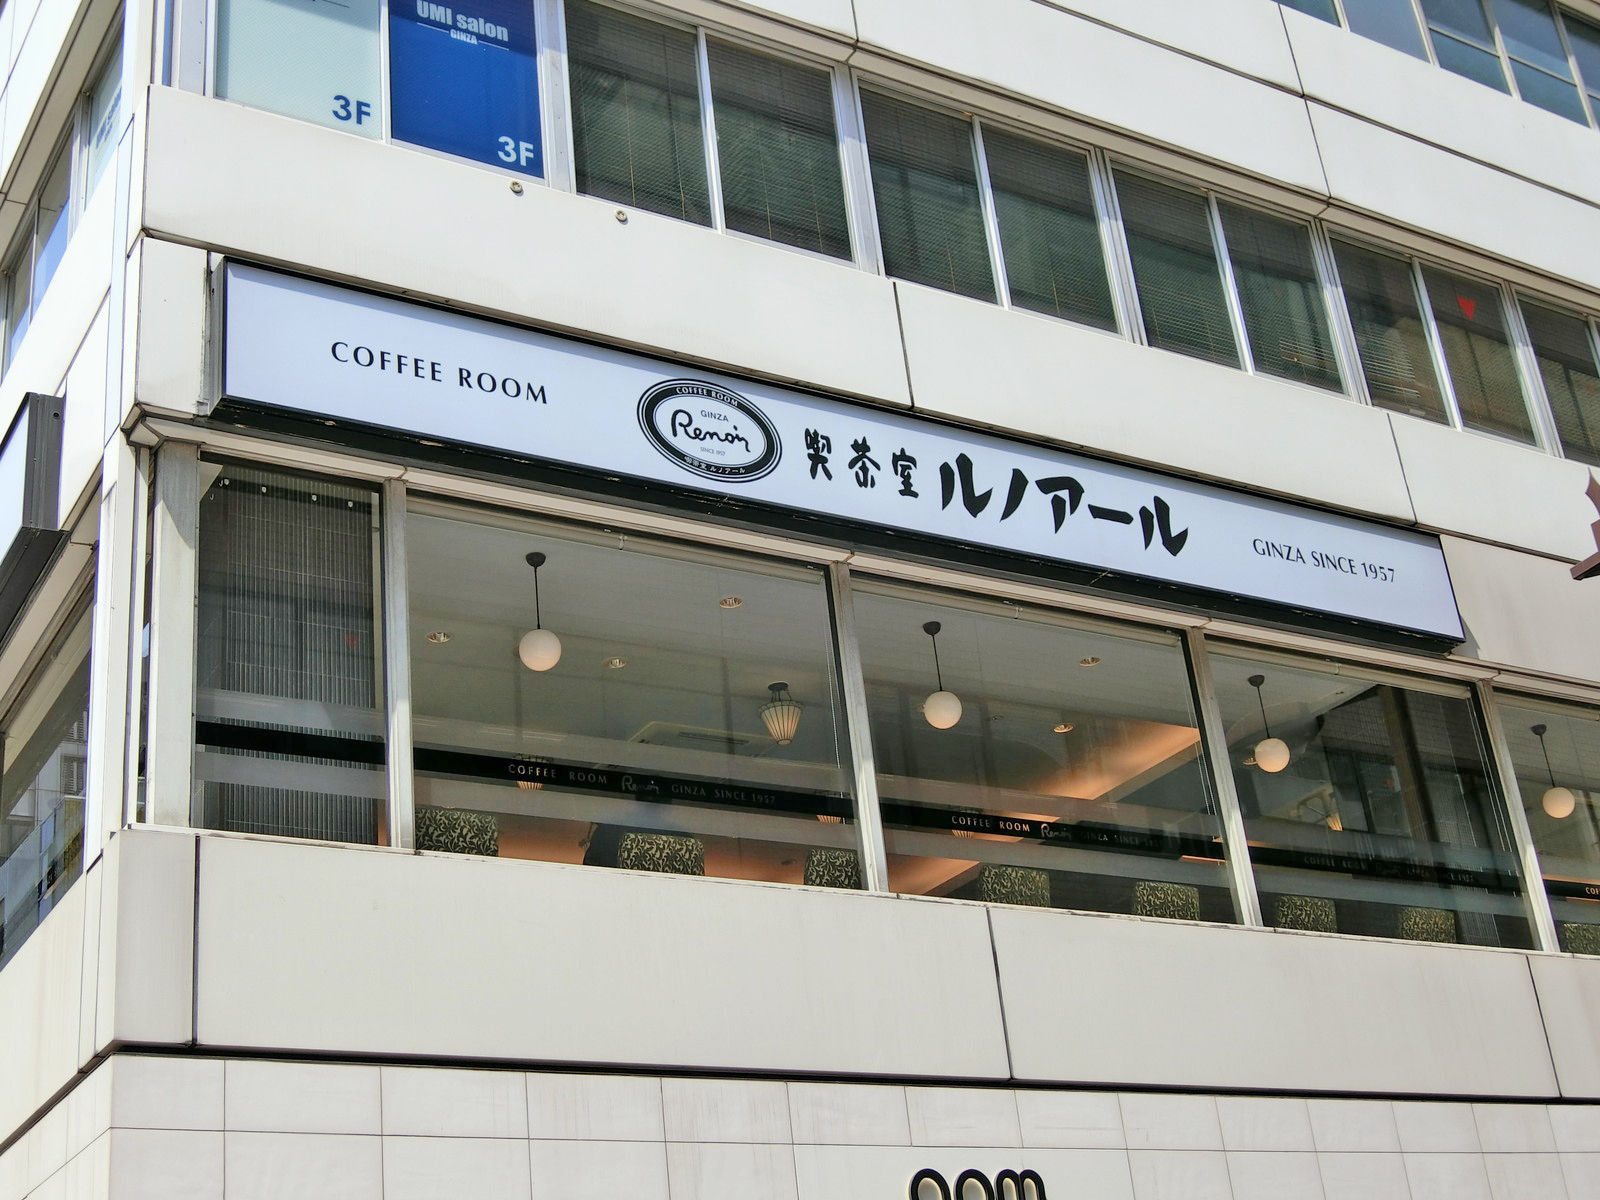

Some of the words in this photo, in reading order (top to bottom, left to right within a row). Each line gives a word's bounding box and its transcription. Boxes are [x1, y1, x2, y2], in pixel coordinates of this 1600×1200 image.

[416, 0, 452, 25] UMI
[456, 14, 509, 42] salon
[450, 29, 478, 45] GINZA
[332, 95, 371, 125] 3F
[497, 136, 534, 167] 3F
[331, 341, 443, 383] COFFEE
[458, 367, 548, 404] ROOM
[676, 386, 708, 396] COFFEE
[711, 391, 739, 407] ROOM
[700, 409, 729, 423] GINZA
[1252, 538, 1306, 564] GINZA
[1310, 550, 1357, 575] SINCE
[1361, 562, 1395, 583] 1957
[508, 763, 557, 778] COFFEE
[568, 770, 608, 785] ROOM
[671, 783, 707, 797] GINZA
[714, 788, 746, 801] SINCE
[951, 815, 990, 829] COFFEE
[999, 820, 1031, 833] ROOM
